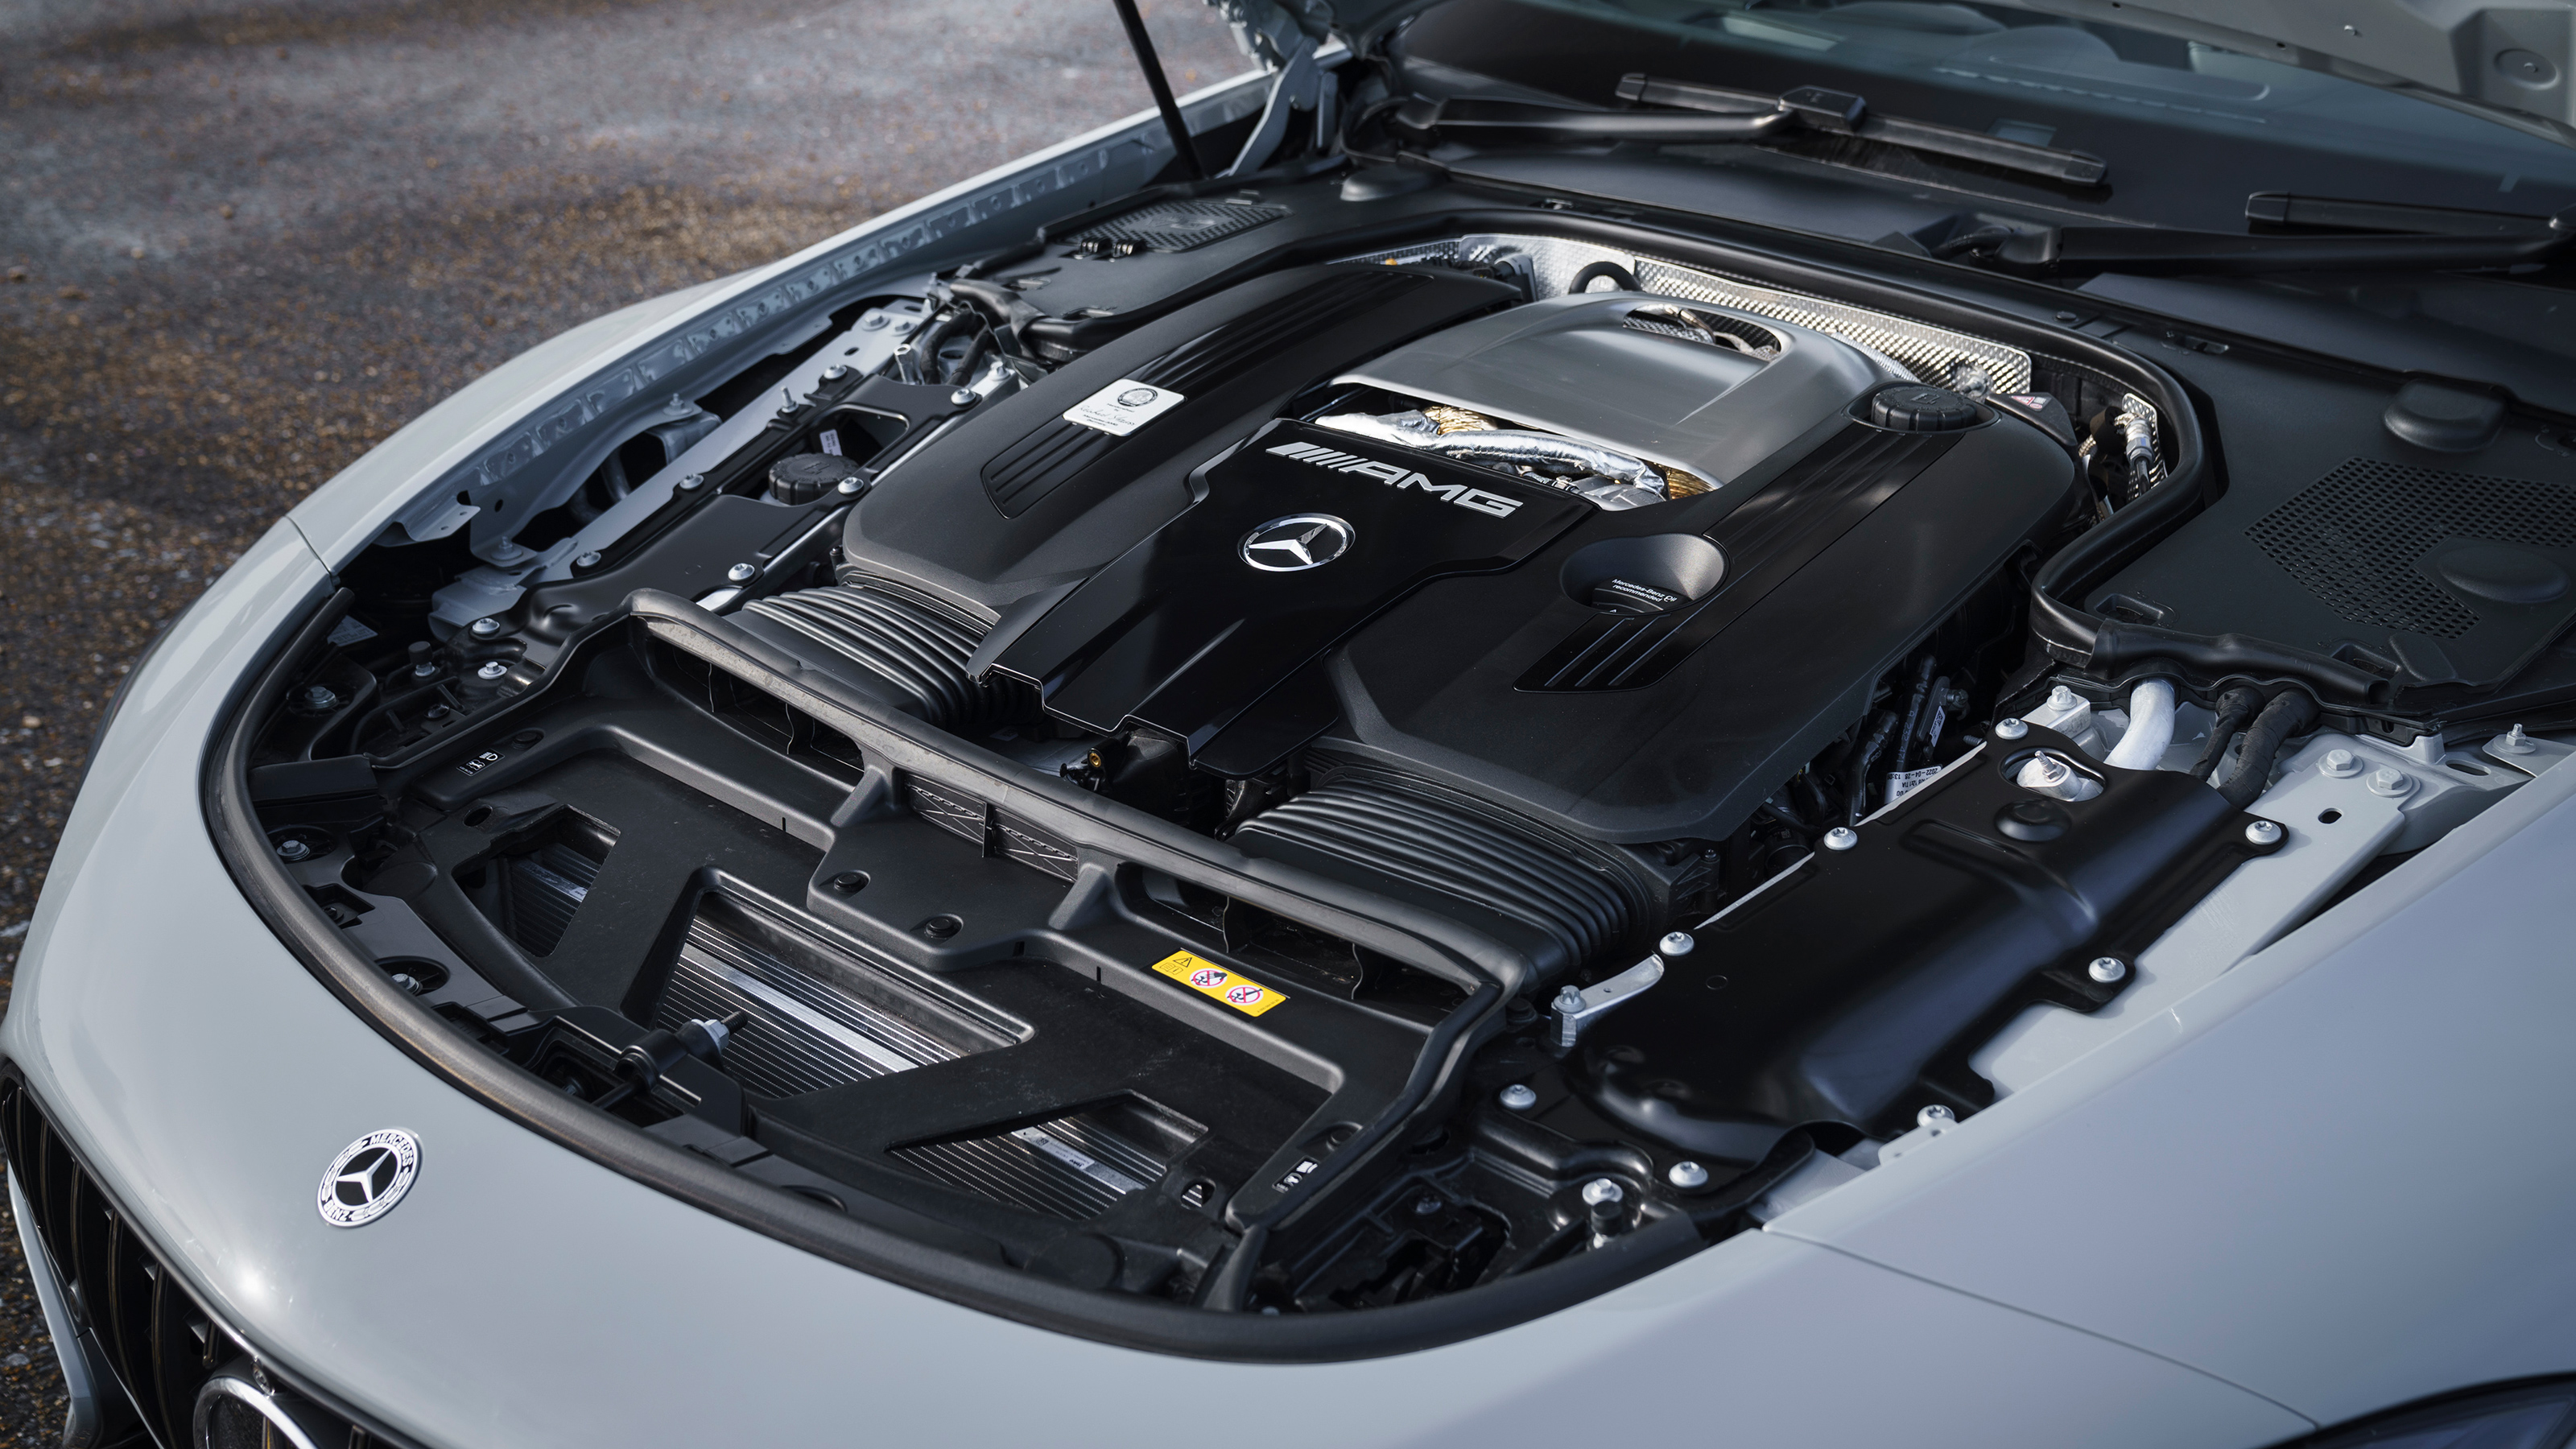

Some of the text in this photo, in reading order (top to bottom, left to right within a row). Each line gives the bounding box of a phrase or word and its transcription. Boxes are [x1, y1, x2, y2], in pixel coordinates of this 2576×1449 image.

[1339, 461, 1524, 518] AMG
[1612, 579, 1678, 603] Mercedes-Benz Oil
[1612, 584, 1662, 602] recommended
[369, 1133, 414, 1167] MERCEDES
[323, 1199, 351, 1222] BENZ
